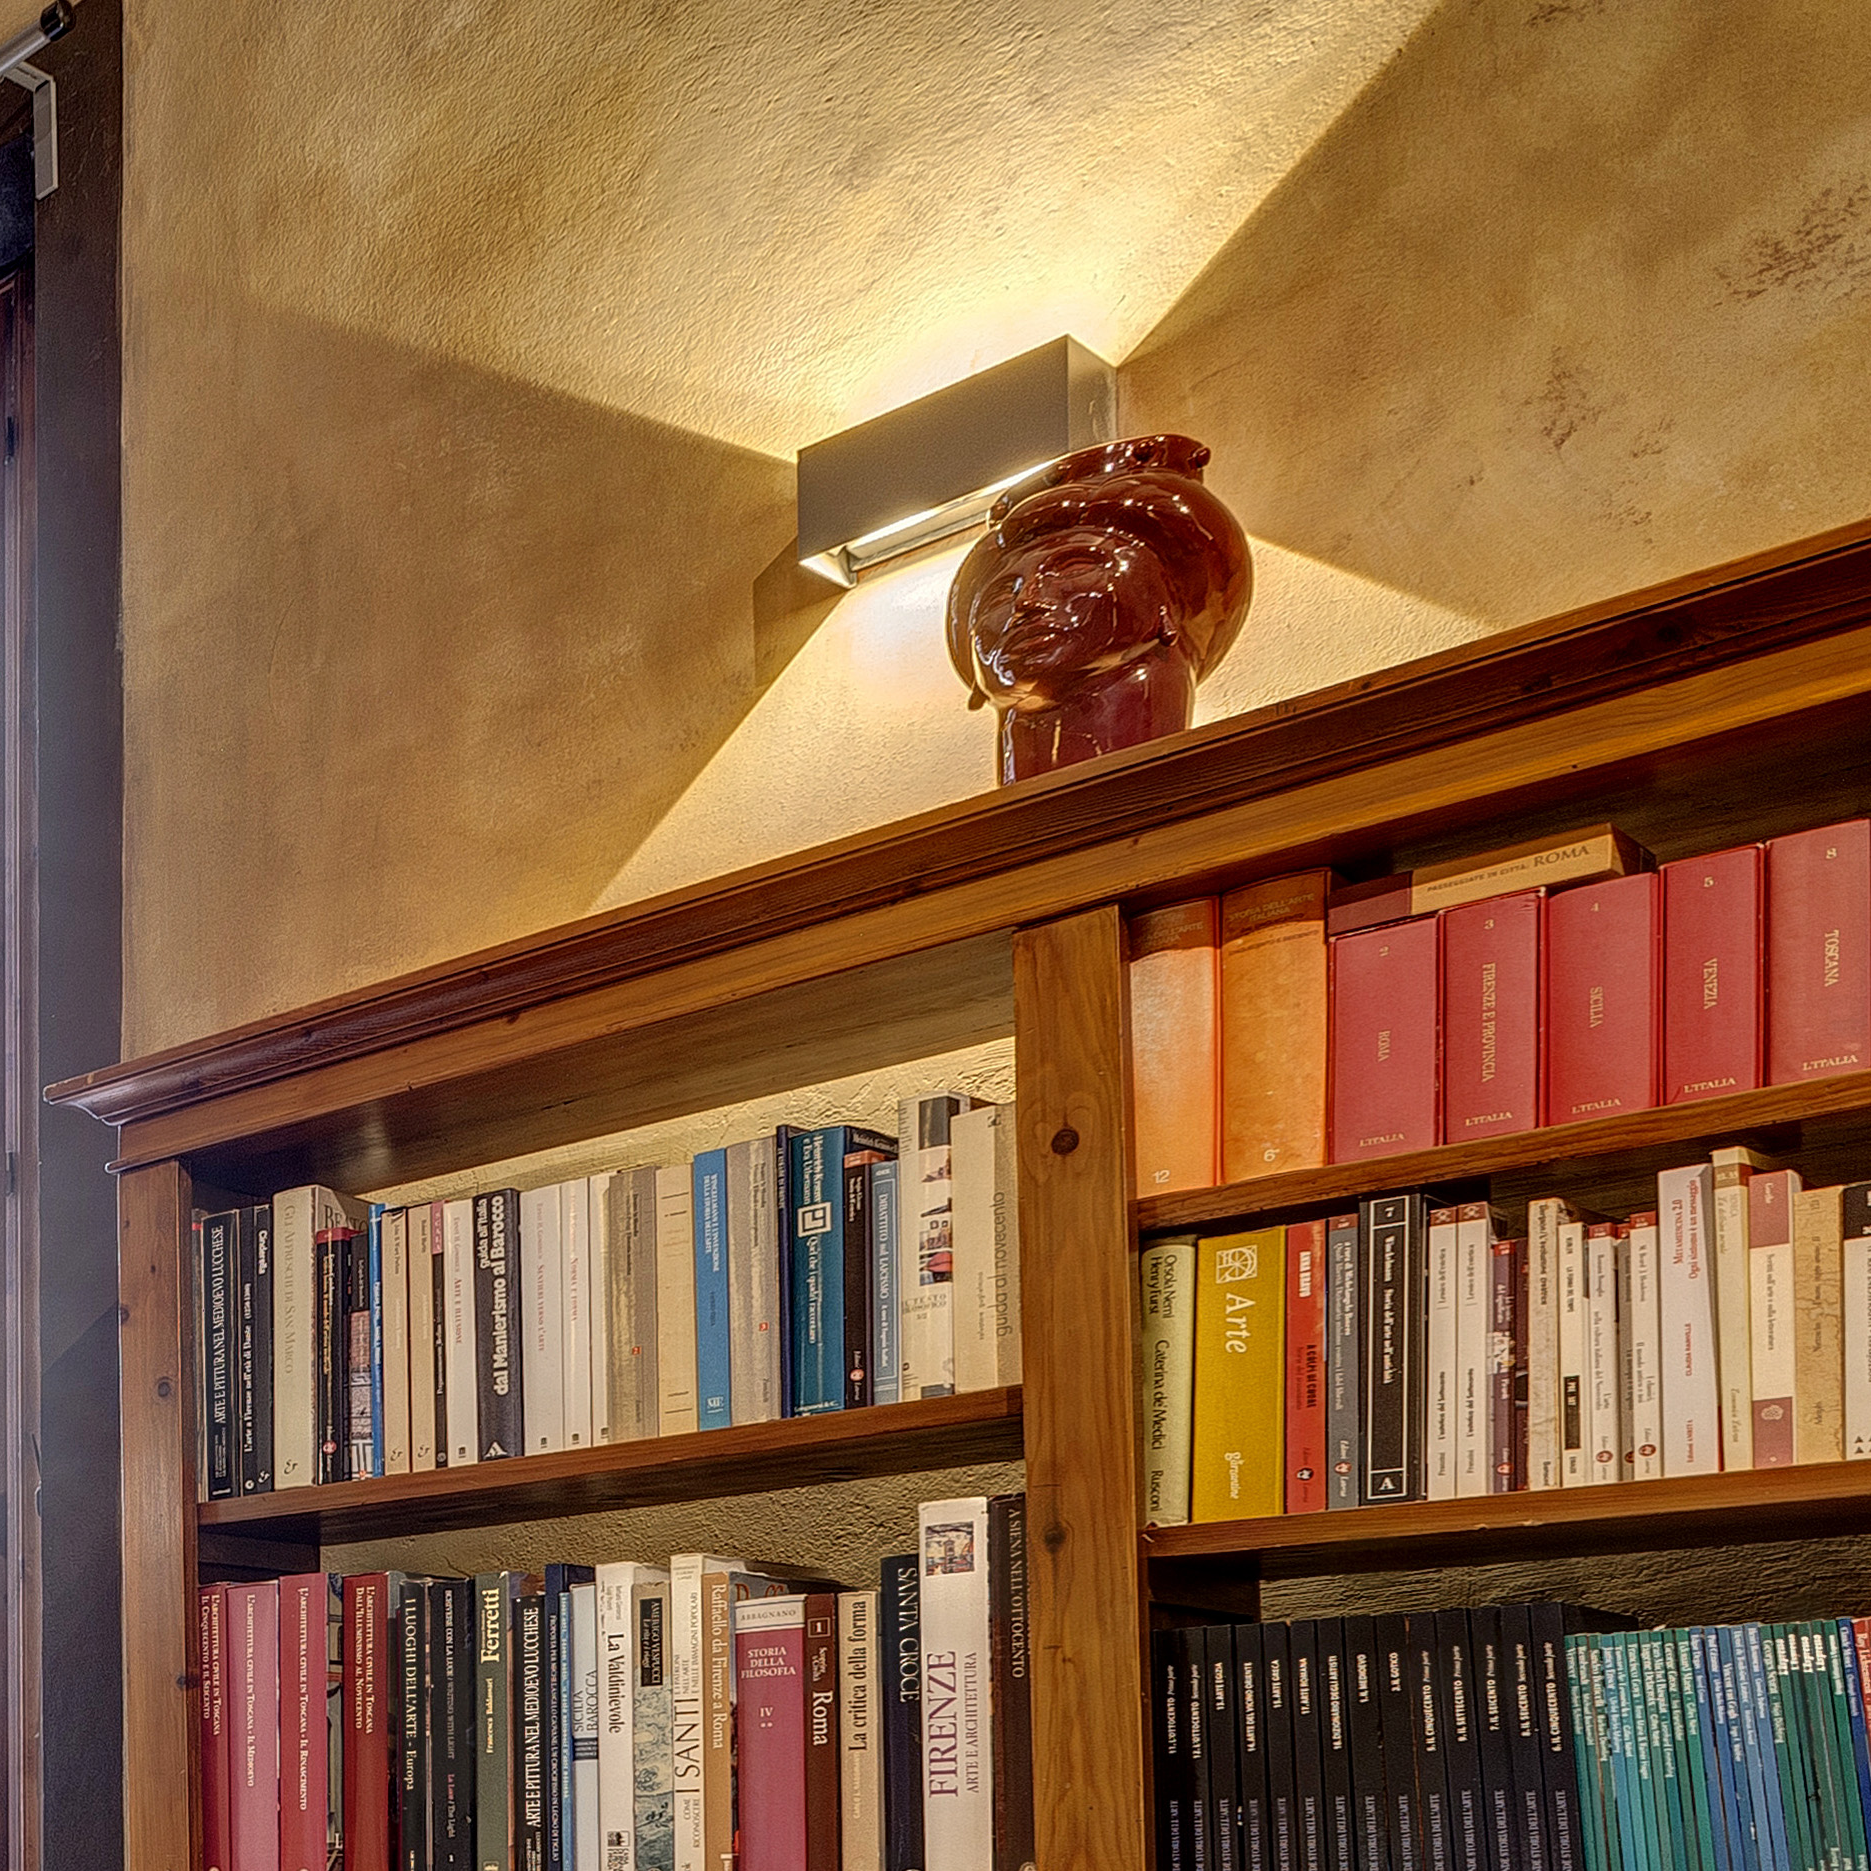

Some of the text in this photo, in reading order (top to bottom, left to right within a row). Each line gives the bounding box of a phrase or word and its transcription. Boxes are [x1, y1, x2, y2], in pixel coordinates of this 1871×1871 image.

[1826, 848, 1837, 859] 8
[1704, 877, 1714, 887] 5
[1484, 920, 1494, 929] 3
[1591, 903, 1600, 912] 4
[1379, 946, 1389, 956] 2
[1824, 930, 1839, 987] TOSCANA
[1590, 987, 1603, 1027] SICILIA
[1704, 958, 1717, 1010] VENEZIA
[1378, 1030, 1390, 1062] ROMA
[1802, 1055, 1858, 1071] L'ITALIA
[1571, 1098, 1621, 1114] L'ITALIA
[1684, 1078, 1735, 1094] L'ITALIA
[1360, 1133, 1404, 1147] L'ITALIA
[1465, 1112, 1512, 1126] L'ITALIA
[1153, 1170, 1170, 1183] 12
[1264, 1150, 1274, 1162] 6
[257, 1230, 268, 1274] Cinderella
[477, 1199, 491, 1268] guida all'Italia
[490, 1196, 508, 1395] dal Manierismo al Barocco
[1161, 1255, 1177, 1318] Orsola Nemi
[1299, 1251, 1311, 1297] ANNA BRAVO
[1225, 1293, 1256, 1354] Arte
[1151, 1340, 1169, 1449] Caterina de' Medici
[1150, 1470, 1164, 1512] Rusconi
[1225, 1452, 1244, 1499] garzantine
[299, 1587, 309, 1655] L'ARCHITETTURA
[1009, 1521, 1024, 1678] SIENA NELL'OTTOCENTO
[480, 1588, 500, 1664] Ferretti
[651, 1602, 661, 1684] AMERIGO VESPUCCI
[898, 1567, 919, 1703] SANTA CROCE
[202, 1606, 211, 1719] CINQUECENTO SEICENTO
[299, 1657, 308, 1682] CIVILE
[365, 1586, 375, 1734] L'ARCHITETTURA CIVILE IN TOSCANA
[710, 1584, 728, 1749] Raffaello da Firenze Roma
[741, 1665, 796, 1678] FILOSOFIA
[748, 1646, 786, 1658] STORIA
[750, 1656, 785, 1667] DELLA
[1357, 1654, 1369, 1688] MEDIOEVO
[247, 1595, 255, 1787] L'ARCHITETTURA TOSCANA MEDIOEVO
[403, 1607, 417, 1790] LUOGHI DELL'ARTE Europa
[607, 1634, 626, 1733] La Valdinievole
[847, 1601, 867, 1751] La critica della forma
[299, 1695, 308, 1732] TOSCANA
[573, 1690, 584, 1732] SICILIA
[586, 1670, 598, 1731] BAROCCA
[760, 1707, 773, 1717] IV
[812, 1691, 833, 1745] Roma
[964, 1652, 979, 1793] ARTE ARCHITETTURA
[1453, 1680, 1467, 1724] SETTECENTO
[1545, 1683, 1561, 1735] CINQUECENTO
[675, 1698, 700, 1778] SANTI
[926, 1651, 959, 1798] FIRENZE
[299, 1751, 308, 1810] RINASCIMENTO
